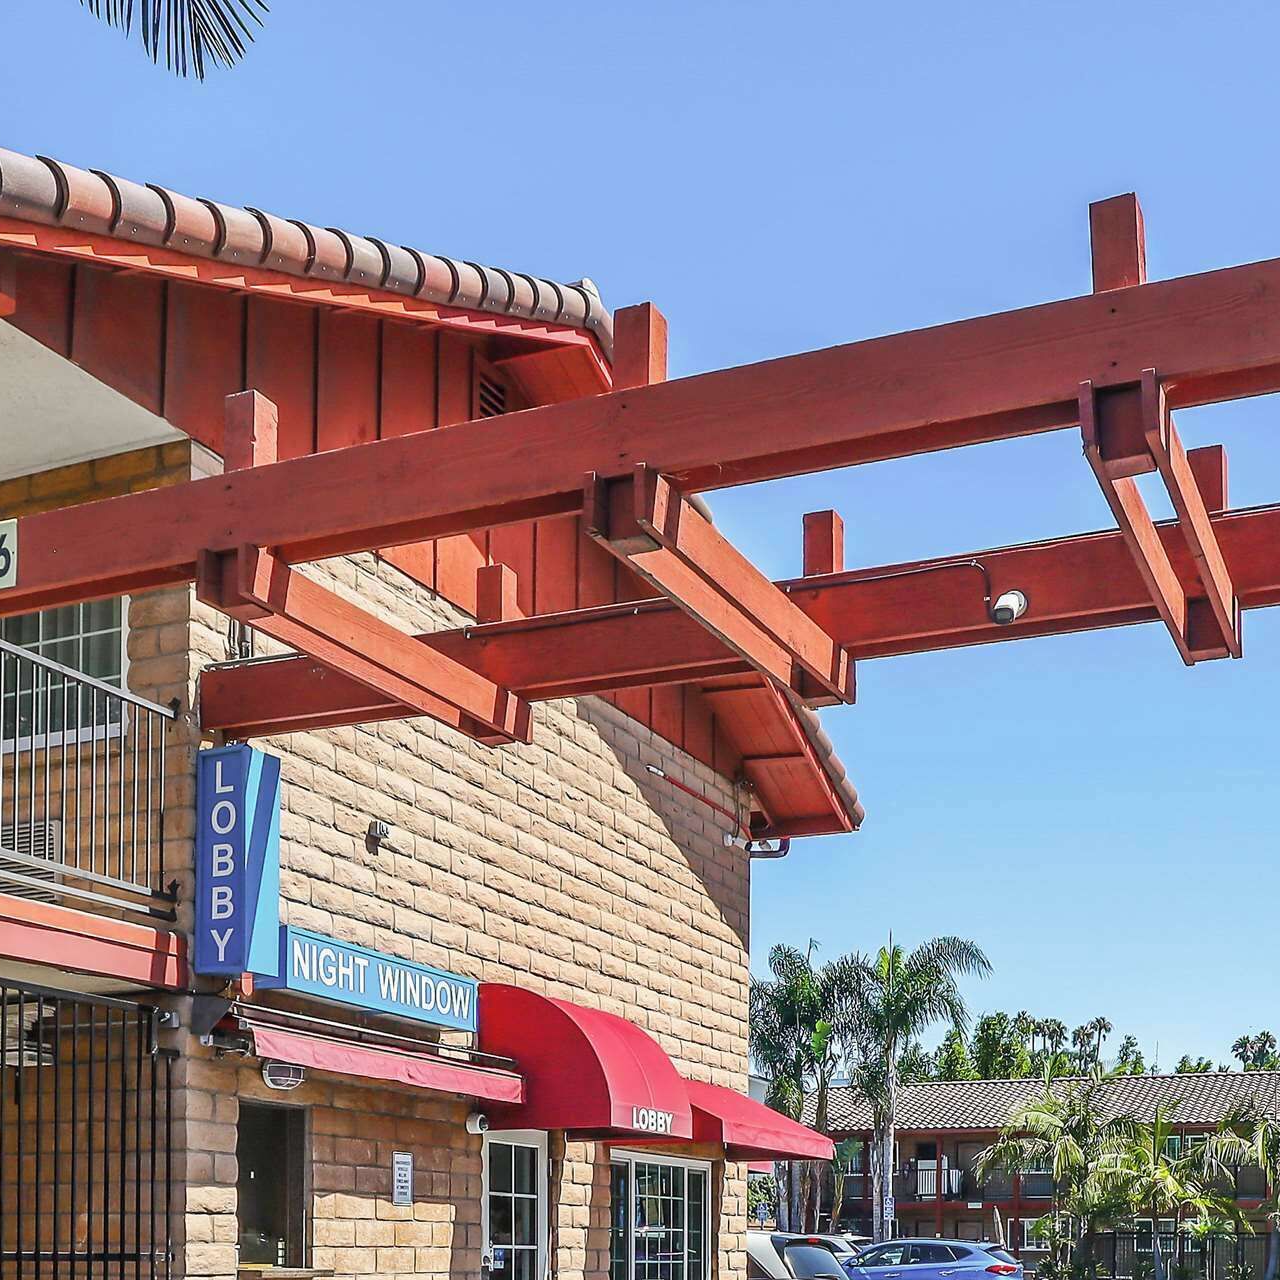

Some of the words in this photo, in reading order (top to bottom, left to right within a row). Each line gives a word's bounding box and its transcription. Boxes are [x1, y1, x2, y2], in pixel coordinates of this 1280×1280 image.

[210, 760, 236, 962] LOBBY
[293, 939, 369, 994] NIGHT
[378, 963, 470, 1020] WINDOW
[632, 1106, 674, 1135] LOBBY
